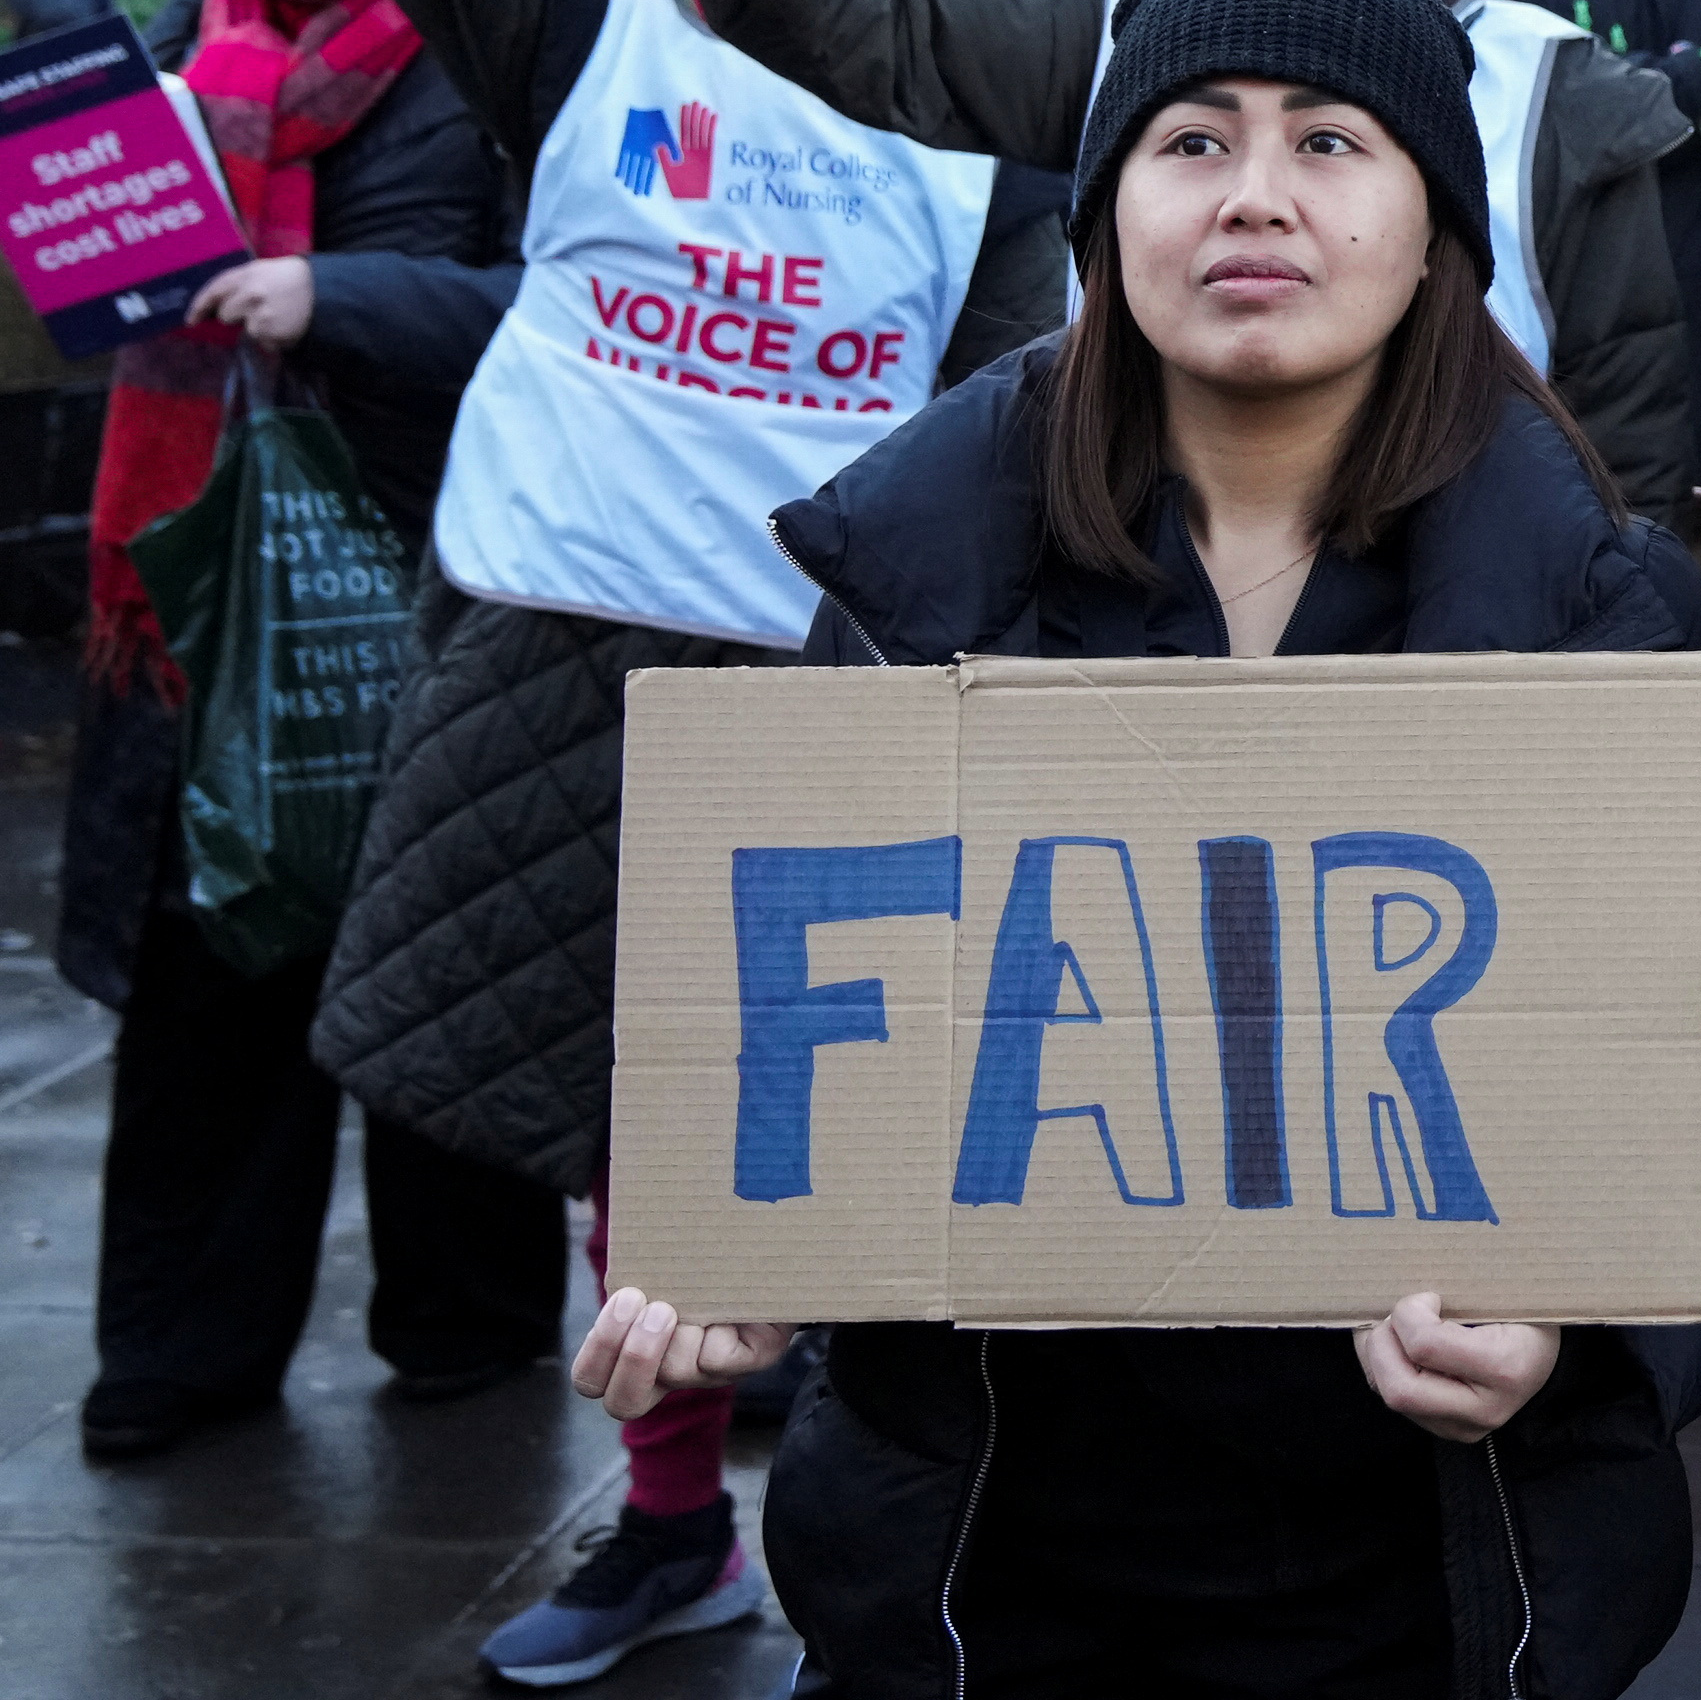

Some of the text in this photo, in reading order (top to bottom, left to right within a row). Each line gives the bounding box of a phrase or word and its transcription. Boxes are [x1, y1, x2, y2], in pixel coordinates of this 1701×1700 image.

[31, 130, 125, 186] Staff
[730, 140, 899, 191] Royal College
[8, 160, 192, 238] shortages
[726, 180, 863, 226] of Nursing
[34, 200, 205, 272] cost lives
[678, 242, 824, 309] THE
[590, 274, 796, 374] VOICE
[816, 330, 905, 381] OF
[294, 640, 380, 676] THIS
[732, 830, 1499, 1224] FAIR
